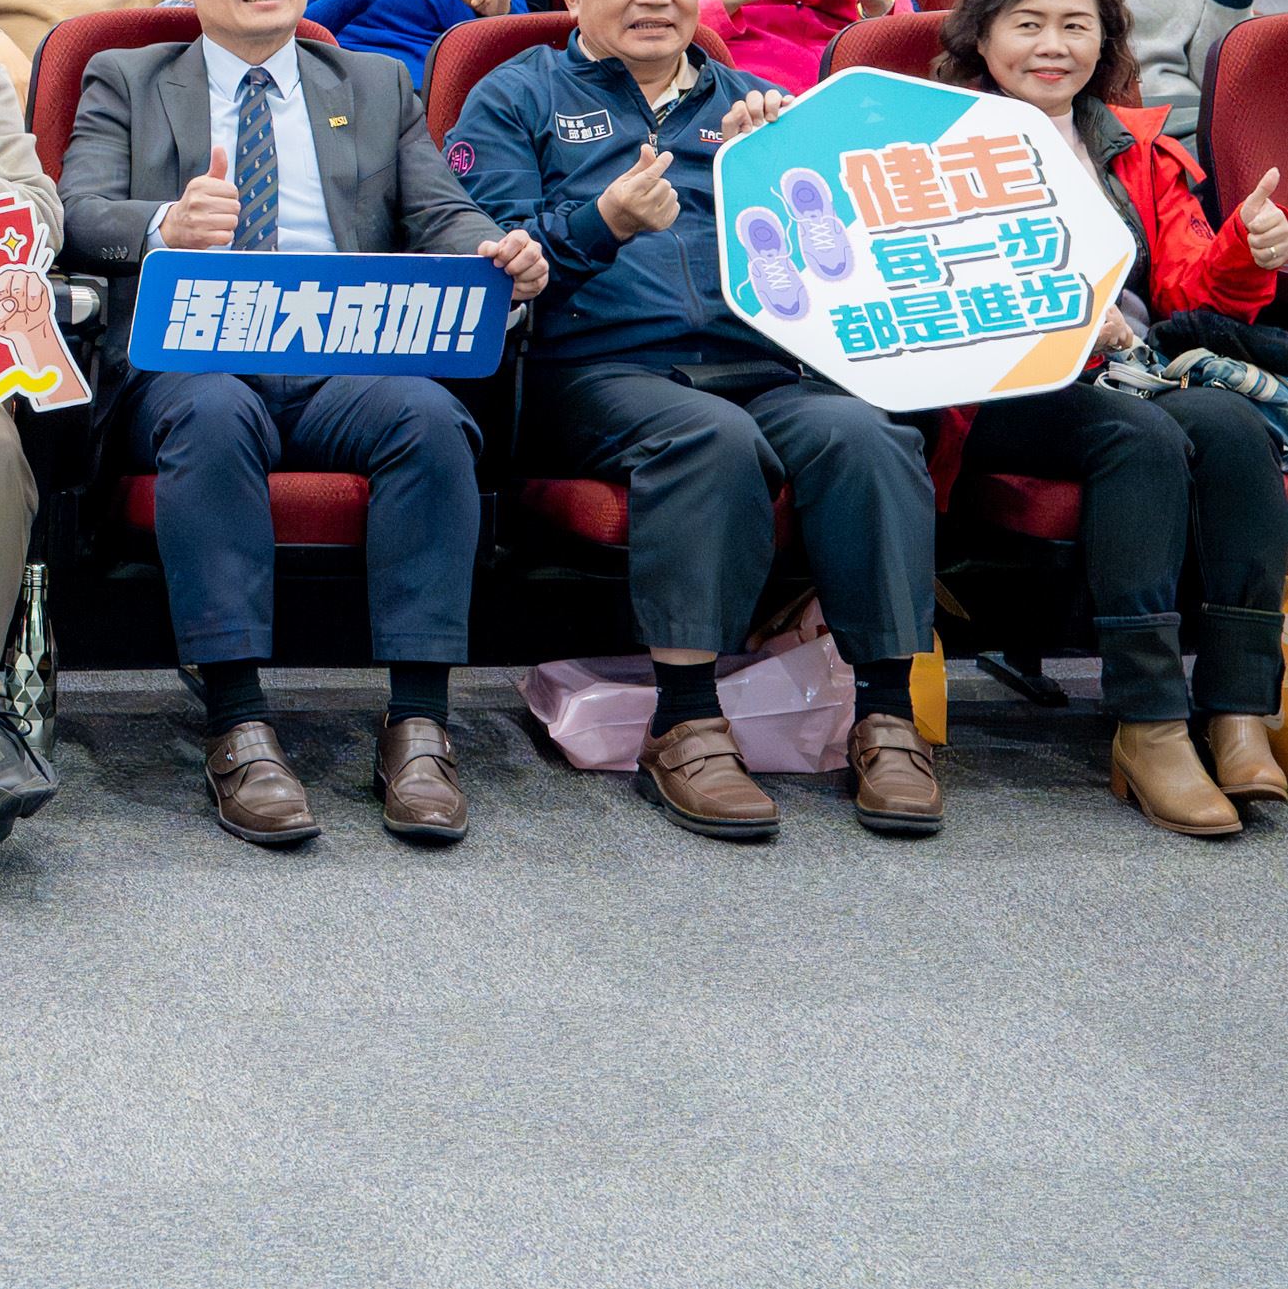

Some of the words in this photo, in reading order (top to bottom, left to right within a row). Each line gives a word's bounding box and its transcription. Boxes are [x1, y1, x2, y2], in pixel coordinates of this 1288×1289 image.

[845, 131, 1048, 230] 健走
[872, 216, 1063, 285] 每一步
[163, 279, 487, 355] 活動大成功!!
[829, 273, 1092, 357] 都是進步
